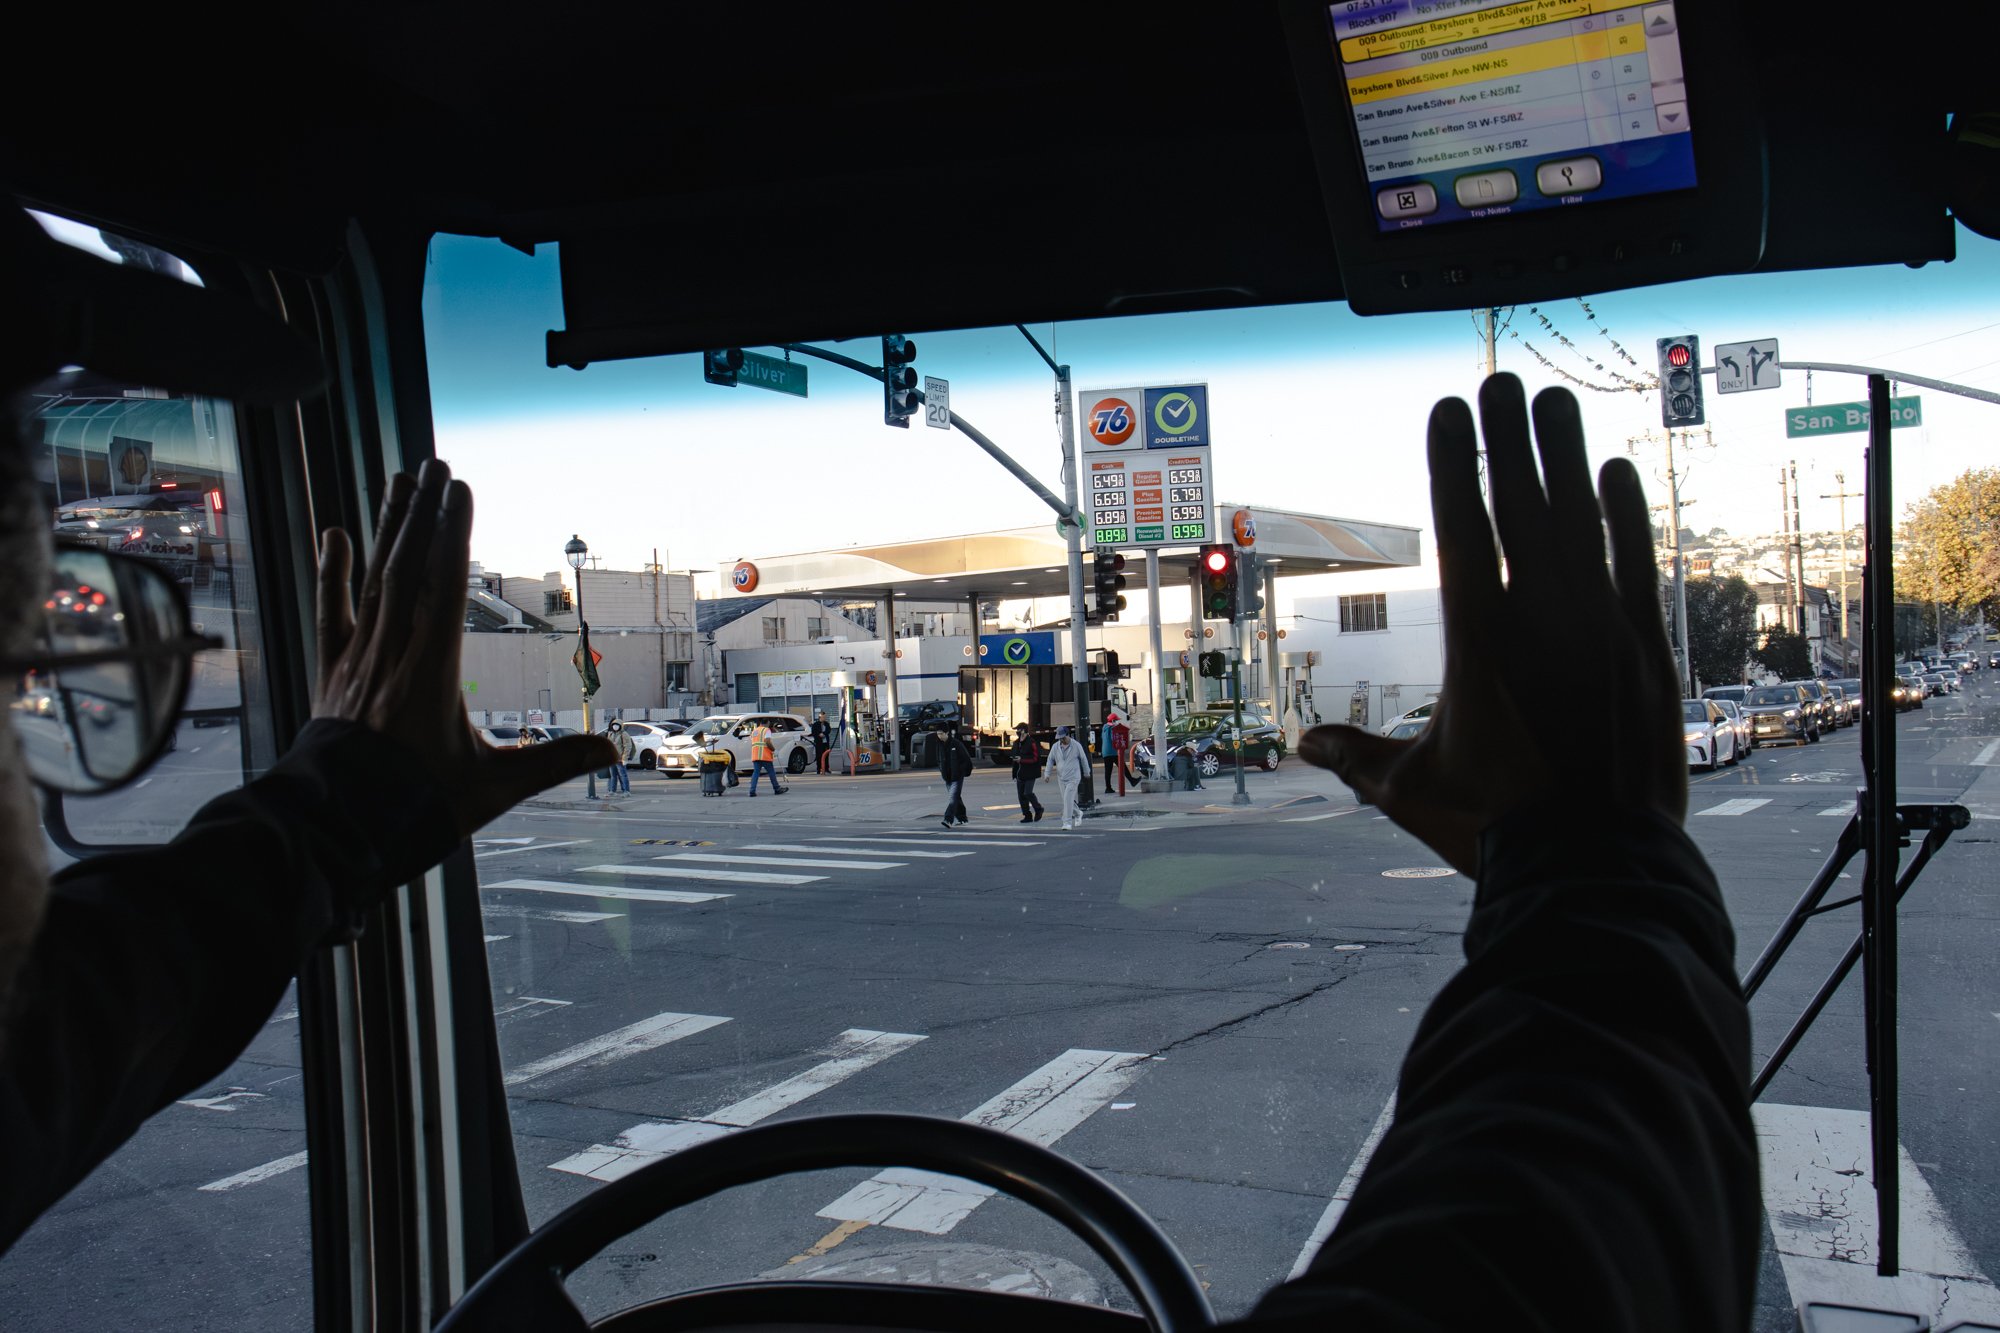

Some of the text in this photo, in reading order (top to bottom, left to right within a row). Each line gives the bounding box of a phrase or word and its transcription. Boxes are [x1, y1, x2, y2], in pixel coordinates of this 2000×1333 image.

[1359, 35, 1377, 47] 009
[1430, 16, 1474, 31] Bayshore
[1477, 4, 1534, 22] Blvd&Silver
[1536, 1, 1556, 11] Ave
[1518, 13, 1547, 25] 45/18
[1400, 38, 1426, 50] 07/16
[1421, 42, 1488, 62] 009 Outbound
[1351, 58, 1508, 96] Bayshore Blvd&Silver Ave NW-NS
[1356, 84, 1522, 122] San Bruno Ave&Silver Ave E-NS/BZ
[1362, 112, 1524, 148] San Bruno Ave&Felton St W-FS/BZ
[1368, 139, 1529, 173] San Bruno Ave&Bacon St W-FS/BZ
[1561, 195, 1583, 205] Filter
[1470, 205, 1512, 218] Trip Notes
[1400, 219, 1423, 228] Close
[740, 359, 786, 384] Silver
[926, 382, 947, 393] SPEED
[1721, 379, 1744, 390] ONLY
[928, 393, 945, 402] LIMIT
[928, 404, 948, 424] 20
[1094, 405, 1129, 435] 76
[1793, 405, 1915, 430] San Brno
[1155, 435, 1200, 444] DOUBLETIME
[733, 567, 750, 586] 76
[859, 752, 871, 764] 76
